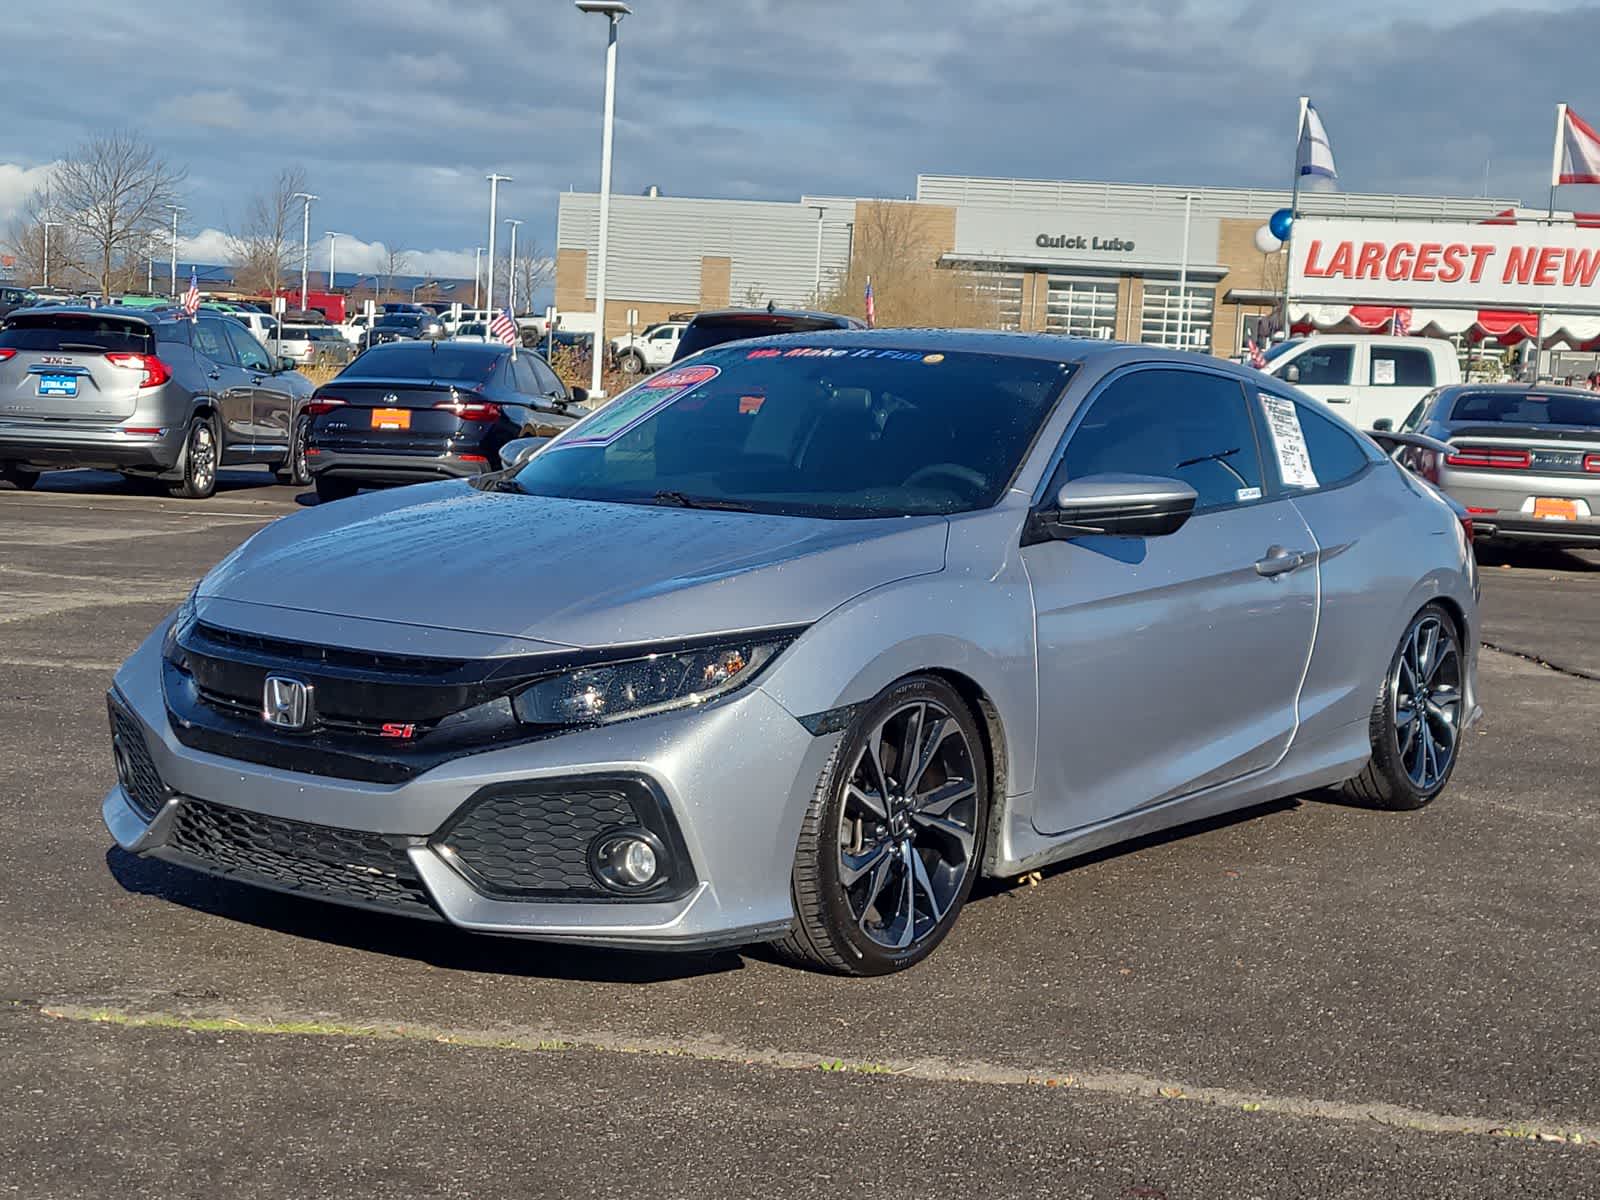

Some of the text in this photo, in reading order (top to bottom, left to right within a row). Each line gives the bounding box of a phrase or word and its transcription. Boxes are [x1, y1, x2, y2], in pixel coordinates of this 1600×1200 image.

[1035, 233, 1135, 252] Quick Lube
[1303, 239, 1600, 287] LARGEST NEW
[380, 723, 416, 738] Si
